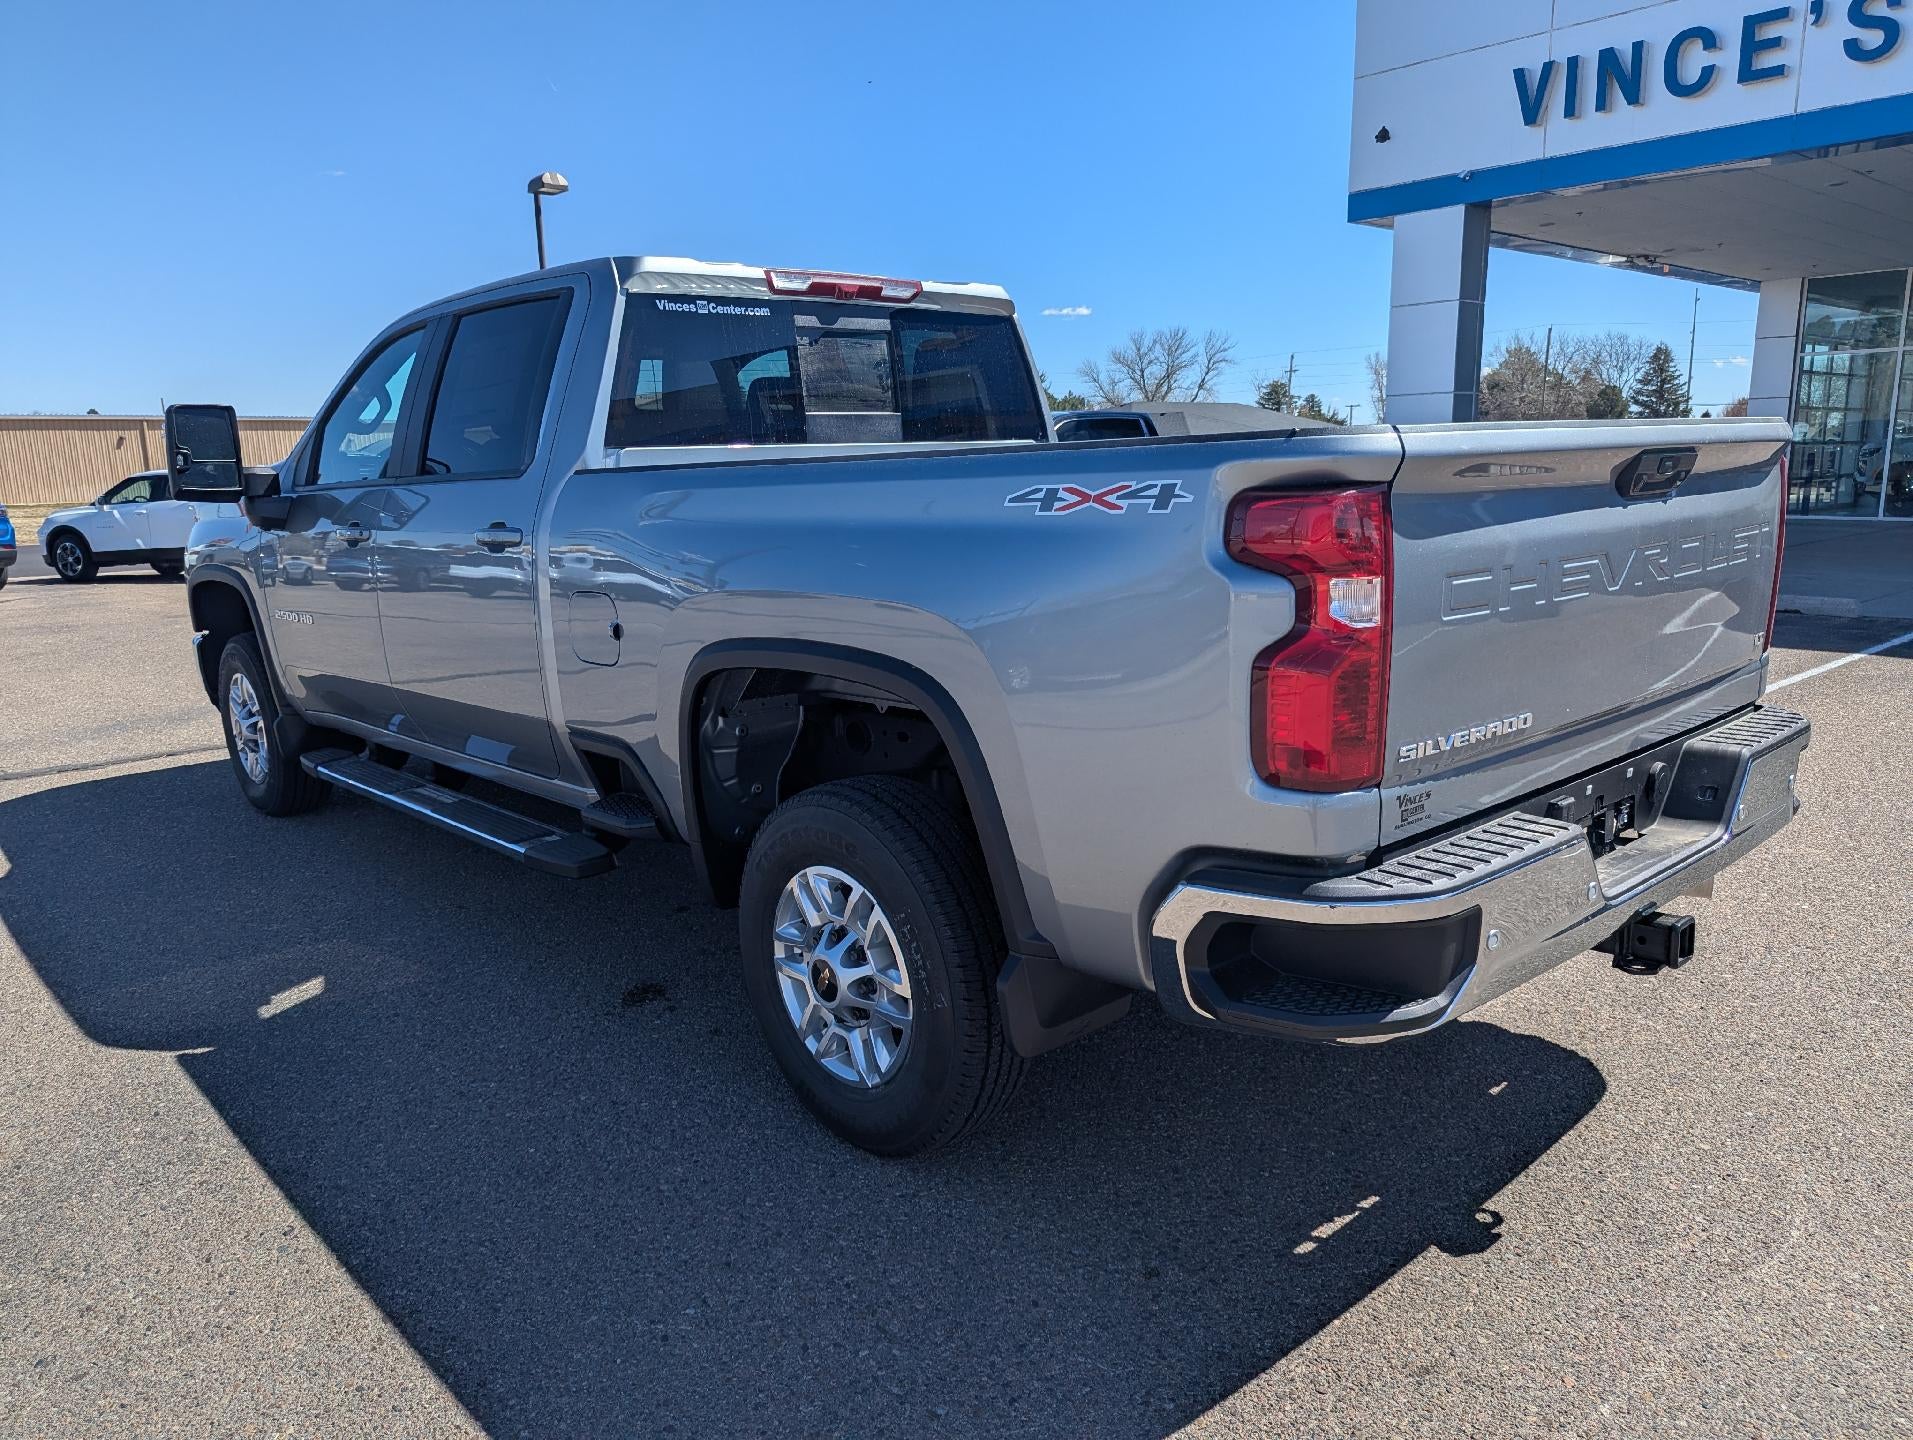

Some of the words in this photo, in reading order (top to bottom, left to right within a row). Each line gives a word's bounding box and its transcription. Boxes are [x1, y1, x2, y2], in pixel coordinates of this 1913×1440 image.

[1440, 521, 1771, 621] CHEVROLET
[275, 609, 299, 622] 2500
[300, 613, 314, 625] HD
[1398, 712, 1534, 763] SILVERADO
